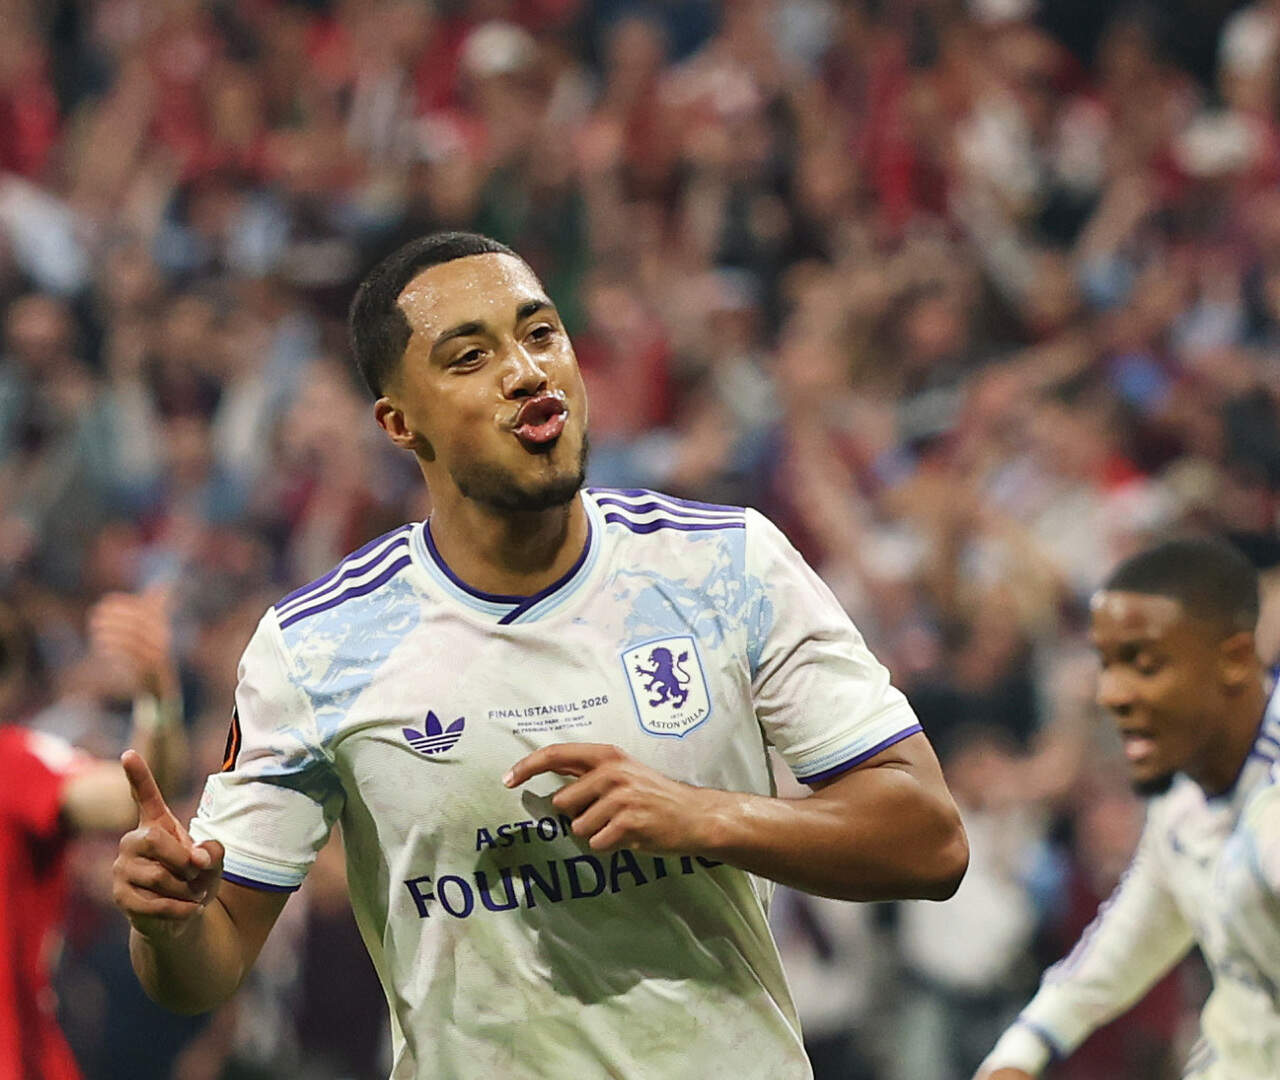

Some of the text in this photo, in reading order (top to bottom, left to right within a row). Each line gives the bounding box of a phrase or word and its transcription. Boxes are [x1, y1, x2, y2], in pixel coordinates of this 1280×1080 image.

[488, 695, 609, 720] FINAL ISTANBUL 2026
[649, 708, 704, 729] ASTON VILLA
[404, 849, 723, 919] FOUNDA
